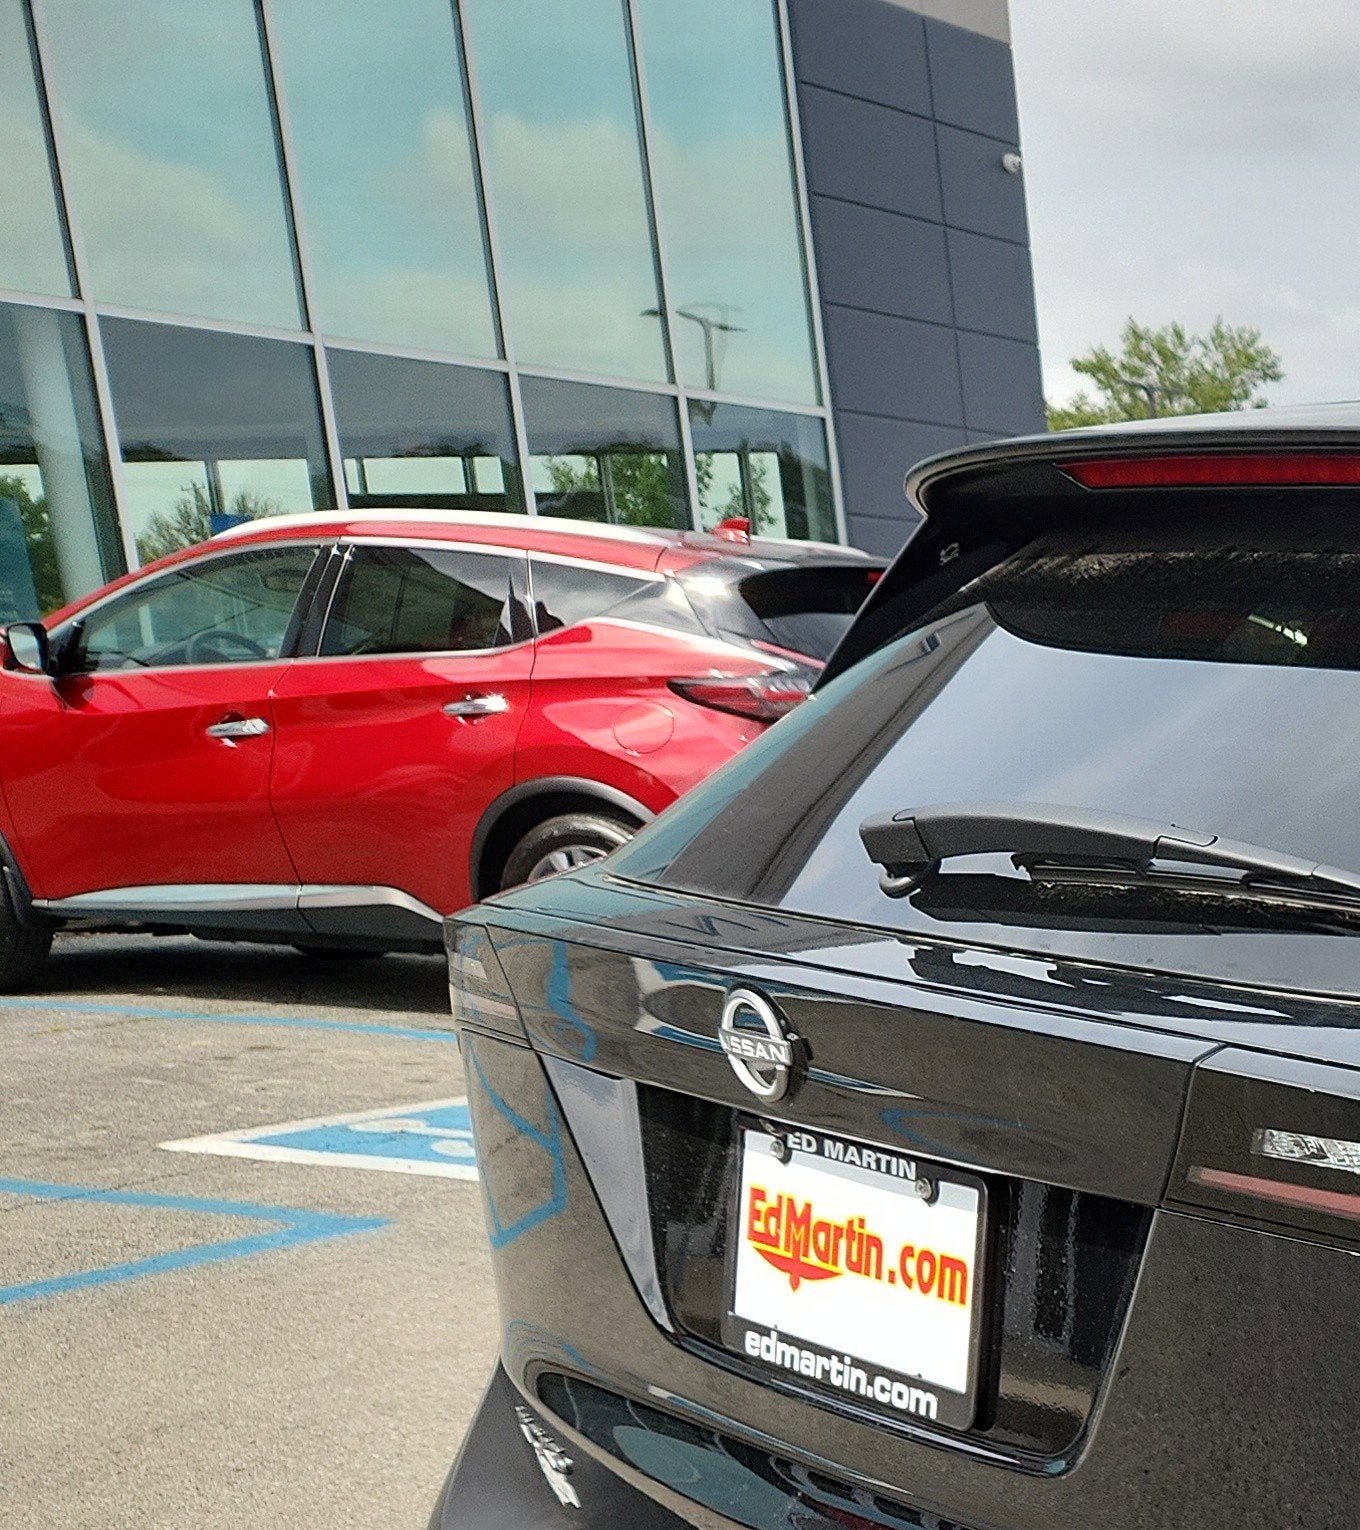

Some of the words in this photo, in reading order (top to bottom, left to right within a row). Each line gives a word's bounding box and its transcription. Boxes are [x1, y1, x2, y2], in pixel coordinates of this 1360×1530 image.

[786, 1132, 818, 1153] ED
[824, 1138, 918, 1180] MARTIN
[746, 1184, 967, 1307] EdMartin.com
[743, 1328, 939, 1420] edmartin.com
